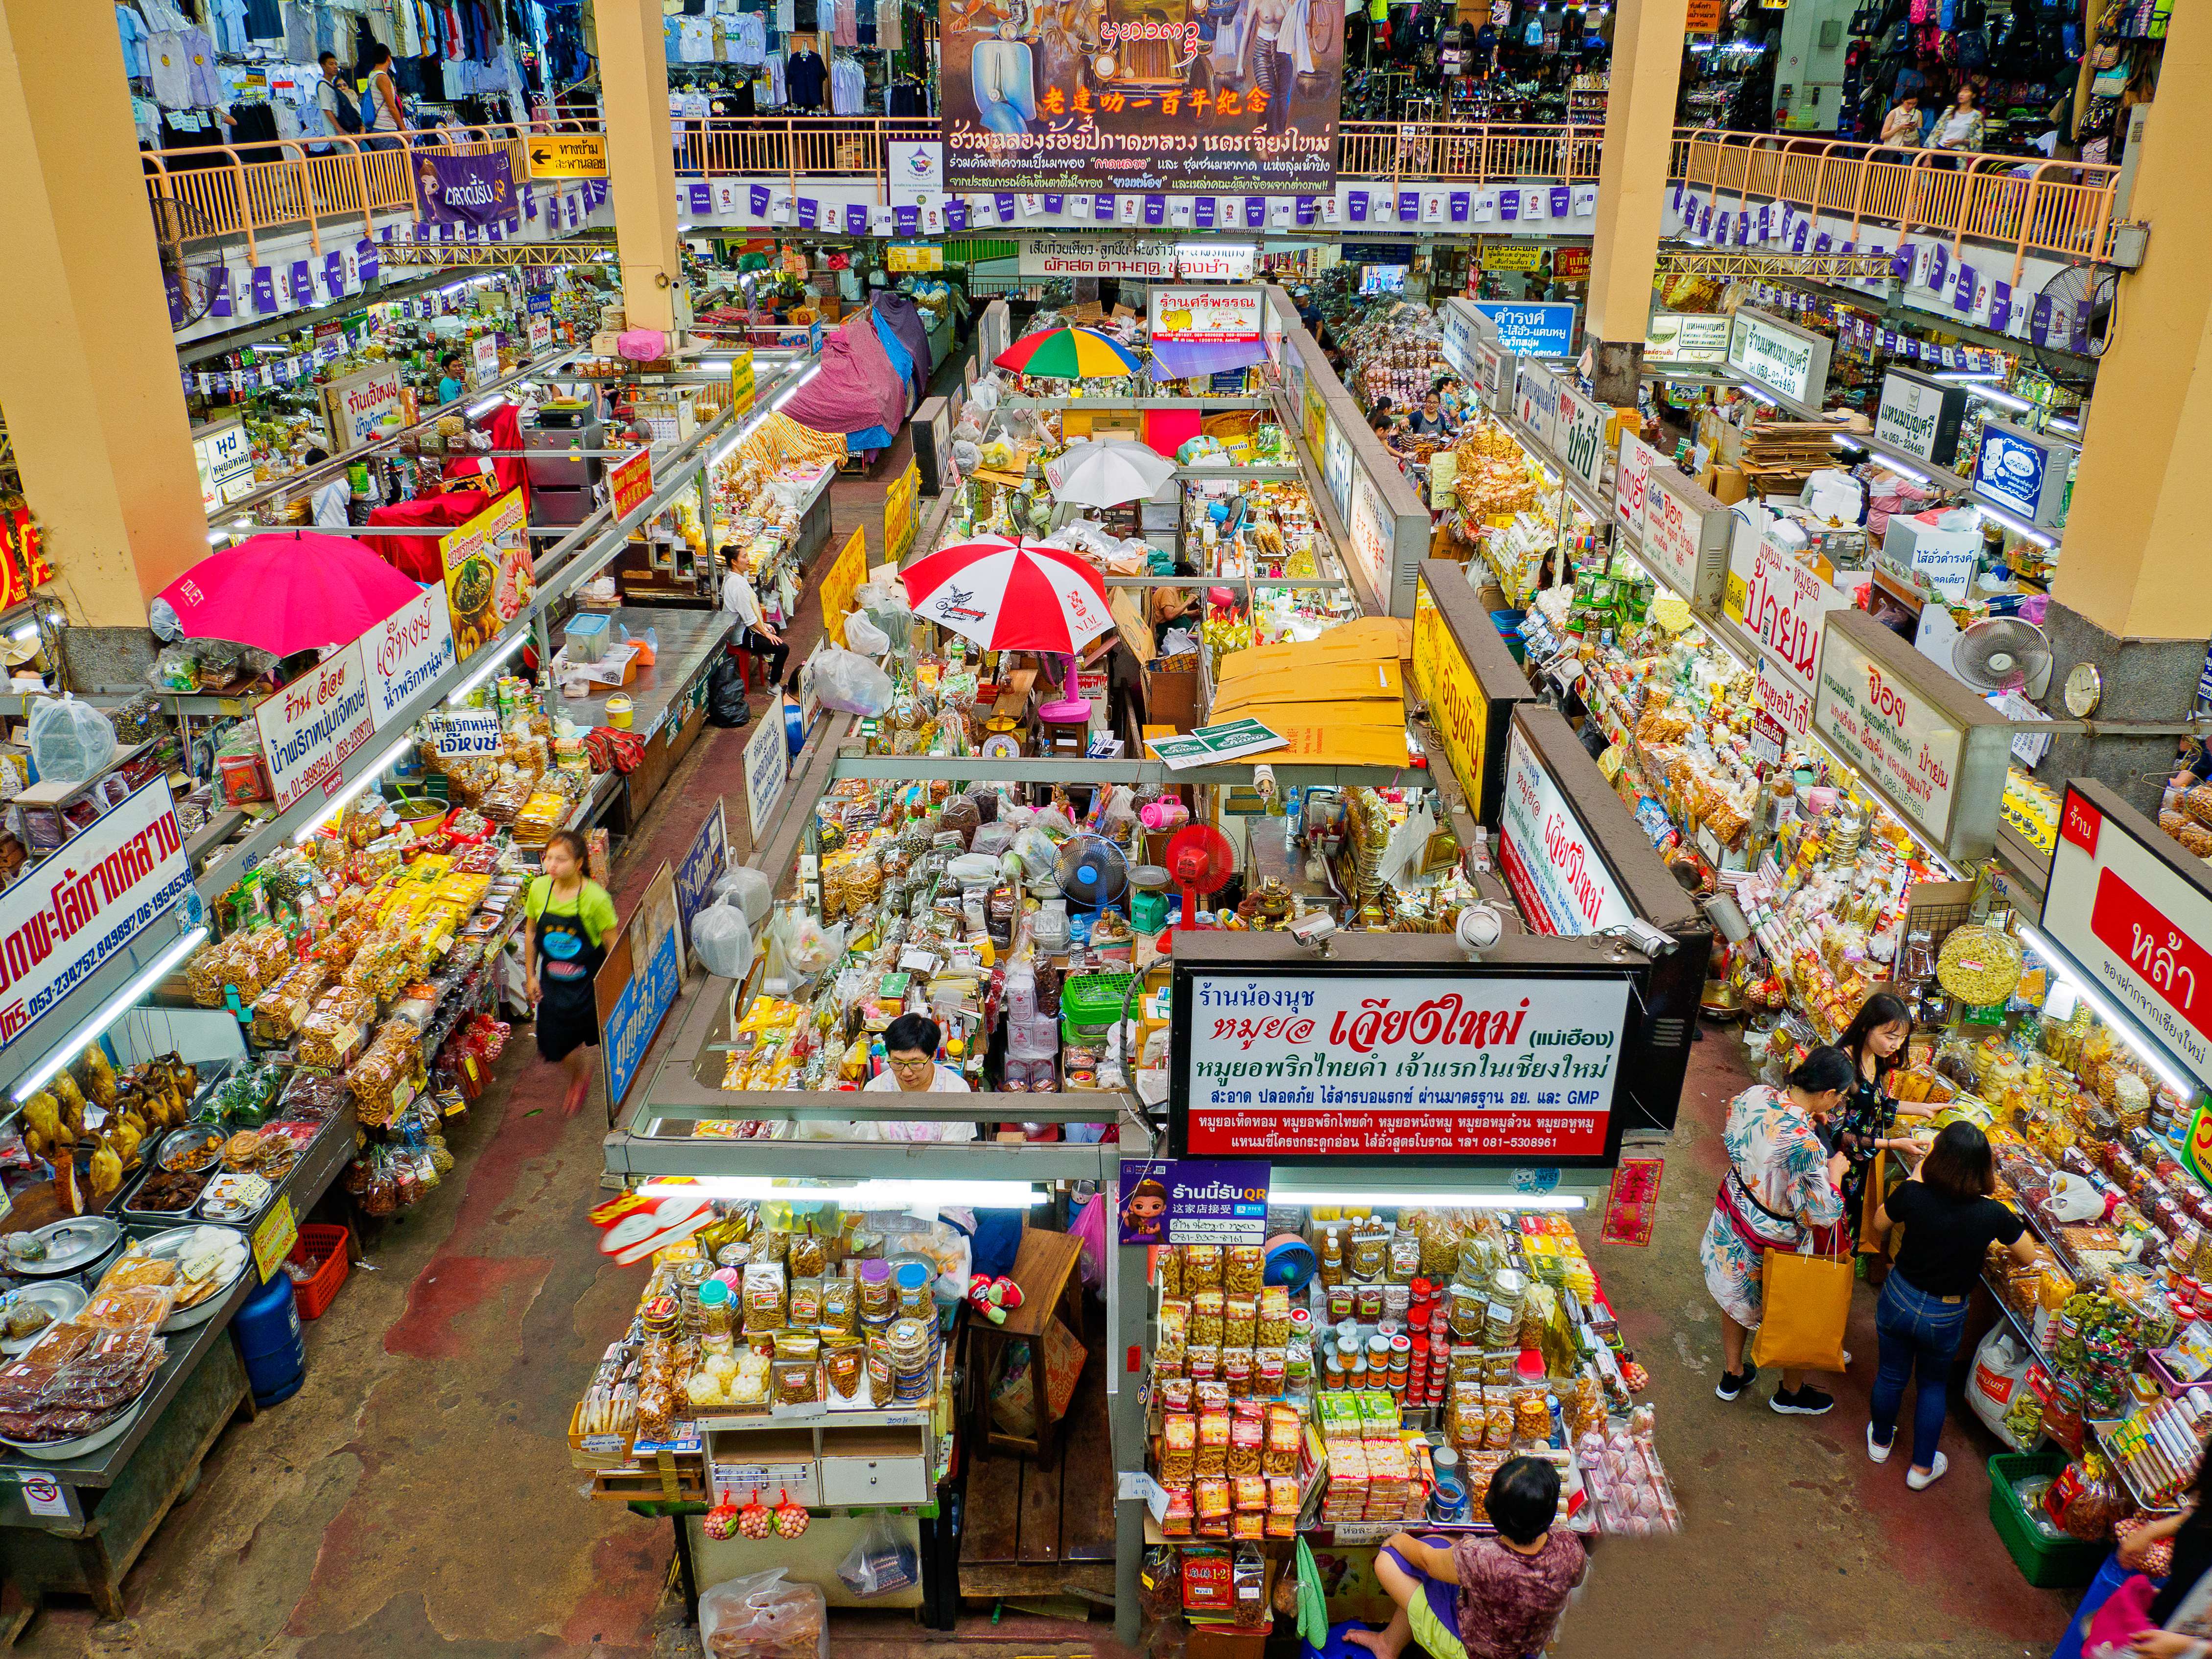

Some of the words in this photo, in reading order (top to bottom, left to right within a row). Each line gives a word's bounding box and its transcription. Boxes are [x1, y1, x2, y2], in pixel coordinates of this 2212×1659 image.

[555, 158, 606, 170] สะพานลอย
[559, 140, 598, 156] ทางข้าม
[1157, 158, 1178, 170] และ
[445, 173, 494, 206] ตลาดนี้รับ
[1044, 258, 1093, 272] ผักสด
[1098, 261, 1160, 275] ตามฤดู
[262, 290, 271, 299] QR
[1160, 293, 1256, 308] ร้านศรีพรรณ
[1494, 307, 1546, 325] ดำรงค์
[1686, 321, 1725, 332] แหนมบุญศรี
[1748, 323, 1809, 376] ร้านแหนมบุญศรี
[1522, 374, 1558, 418] แคบหมูแม่โจ้
[1881, 404, 1935, 440] แหนมบุญศรี
[217, 431, 237, 458] นุช
[1664, 493, 1683, 530] จอย
[1759, 540, 1782, 570] แหนม
[1793, 564, 1820, 602] หมูยอ
[1916, 547, 1975, 564] ไส้อั่วดำรงค์
[180, 578, 205, 607] DUET
[1725, 579, 1746, 614] เนื้อเค็ม
[1074, 614, 1098, 635] NIM
[1744, 558, 1818, 682] ป้าย่น
[283, 691, 311, 724] ร้าน
[317, 661, 348, 706] อ้อย
[383, 651, 443, 711] น้ำพริกหนุ่ม
[1867, 664, 1906, 727] จอย
[270, 680, 366, 775] น้ำพริกหนุ่มเจ๊หงษ์
[431, 711, 498, 733] น้ำพริกหนุ่ม
[1754, 714, 1784, 745] เนื้อเค็ม
[1513, 730, 1540, 789] ร้านน้องนุช
[1860, 702, 1912, 760] หมูยอพริกไทยดำ
[1918, 743, 1949, 791] ป้าย่น
[1516, 771, 1540, 821] หมูยอ
[2070, 805, 2091, 839] ร้าน
[0, 809, 182, 995] ดพะโล้กาดหลวง
[2131, 922, 2196, 1010] หล้า
[1199, 982, 1315, 1014] ร้านน้องนุช
[2103, 960, 2206, 1065] ของฝากจากเชียงใหม่
[1210, 1015, 1316, 1051] หมูยอ
[1529, 1028, 1614, 1049] (แม่เฮือง)
[1196, 1052, 1387, 1088] หมูยอพริกไทยดำ
[1395, 1051, 1611, 1081] เจ้าแรกในเชียงใหม่
[1211, 1088, 1251, 1104] สะอาด
[1258, 1086, 1314, 1104] ปลอดภัย
[1320, 1085, 1414, 1105] ไร้สารบอแรกซ์
[1419, 1086, 1504, 1109] ผ่านมาตรฐาน
[1510, 1091, 1530, 1104] อย.
[1537, 1092, 1561, 1105] และ
[1567, 1090, 1600, 1105] GMP
[1199, 1113, 1277, 1132] หมูยอเห็ดหอม
[1282, 1113, 1373, 1132] หมูยอพริกไทยดำ
[1378, 1114, 1452, 1132] หมูยอหนังหมู
[1459, 1114, 1531, 1132] หมูยอหมูล้วน
[1537, 1118, 1594, 1132] หมูยอหูหมู
[1483, 1135, 1556, 1148] 081-5308961
[1173, 1181, 1243, 1200] ร้านนี้รับ
[1244, 1189, 1266, 1200] QR
[1173, 1204, 1231, 1214] 这家店接受
[1342, 1525, 1372, 1536] ห่อละ
[1189, 1568, 1212, 1580] 麻辣
[1212, 1567, 1227, 1580] 1+2
